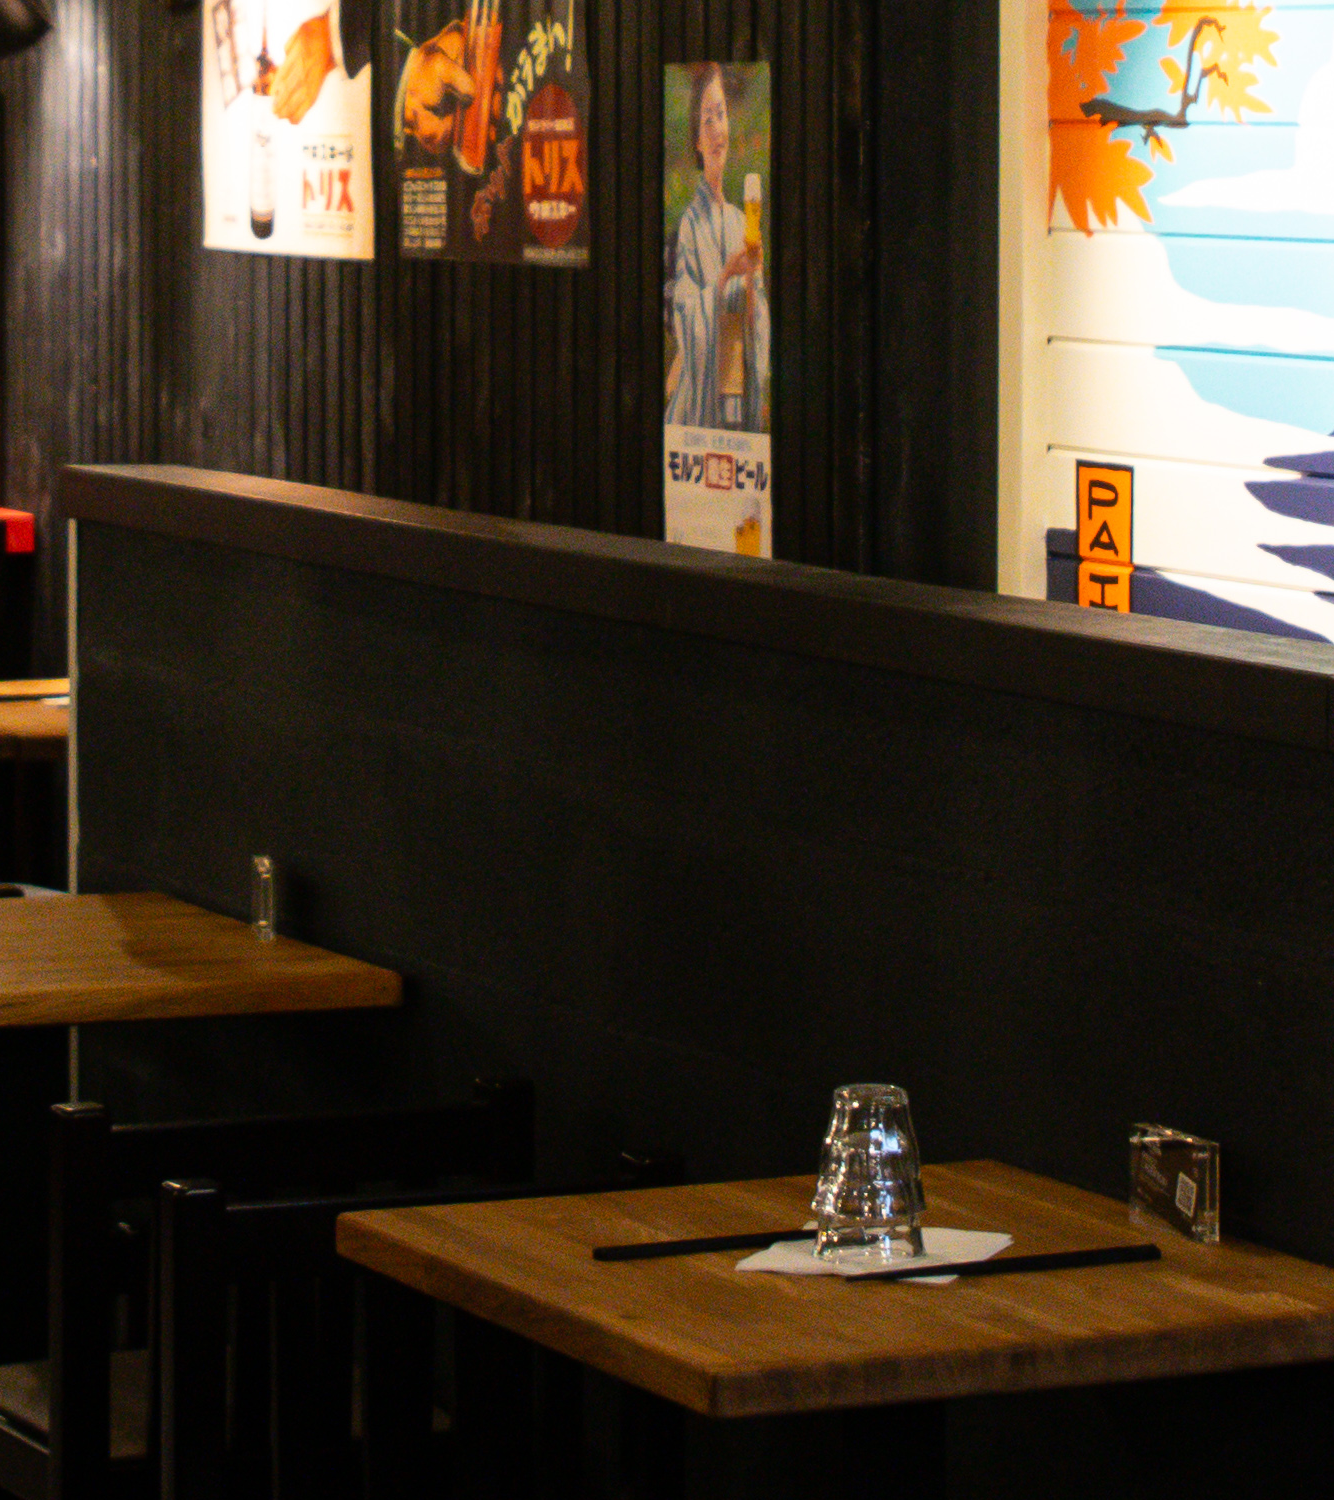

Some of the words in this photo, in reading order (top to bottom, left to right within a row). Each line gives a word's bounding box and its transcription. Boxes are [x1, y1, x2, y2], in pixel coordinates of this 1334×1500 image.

[302, 168, 354, 212] トリス
[524, 139, 584, 194] トリス
